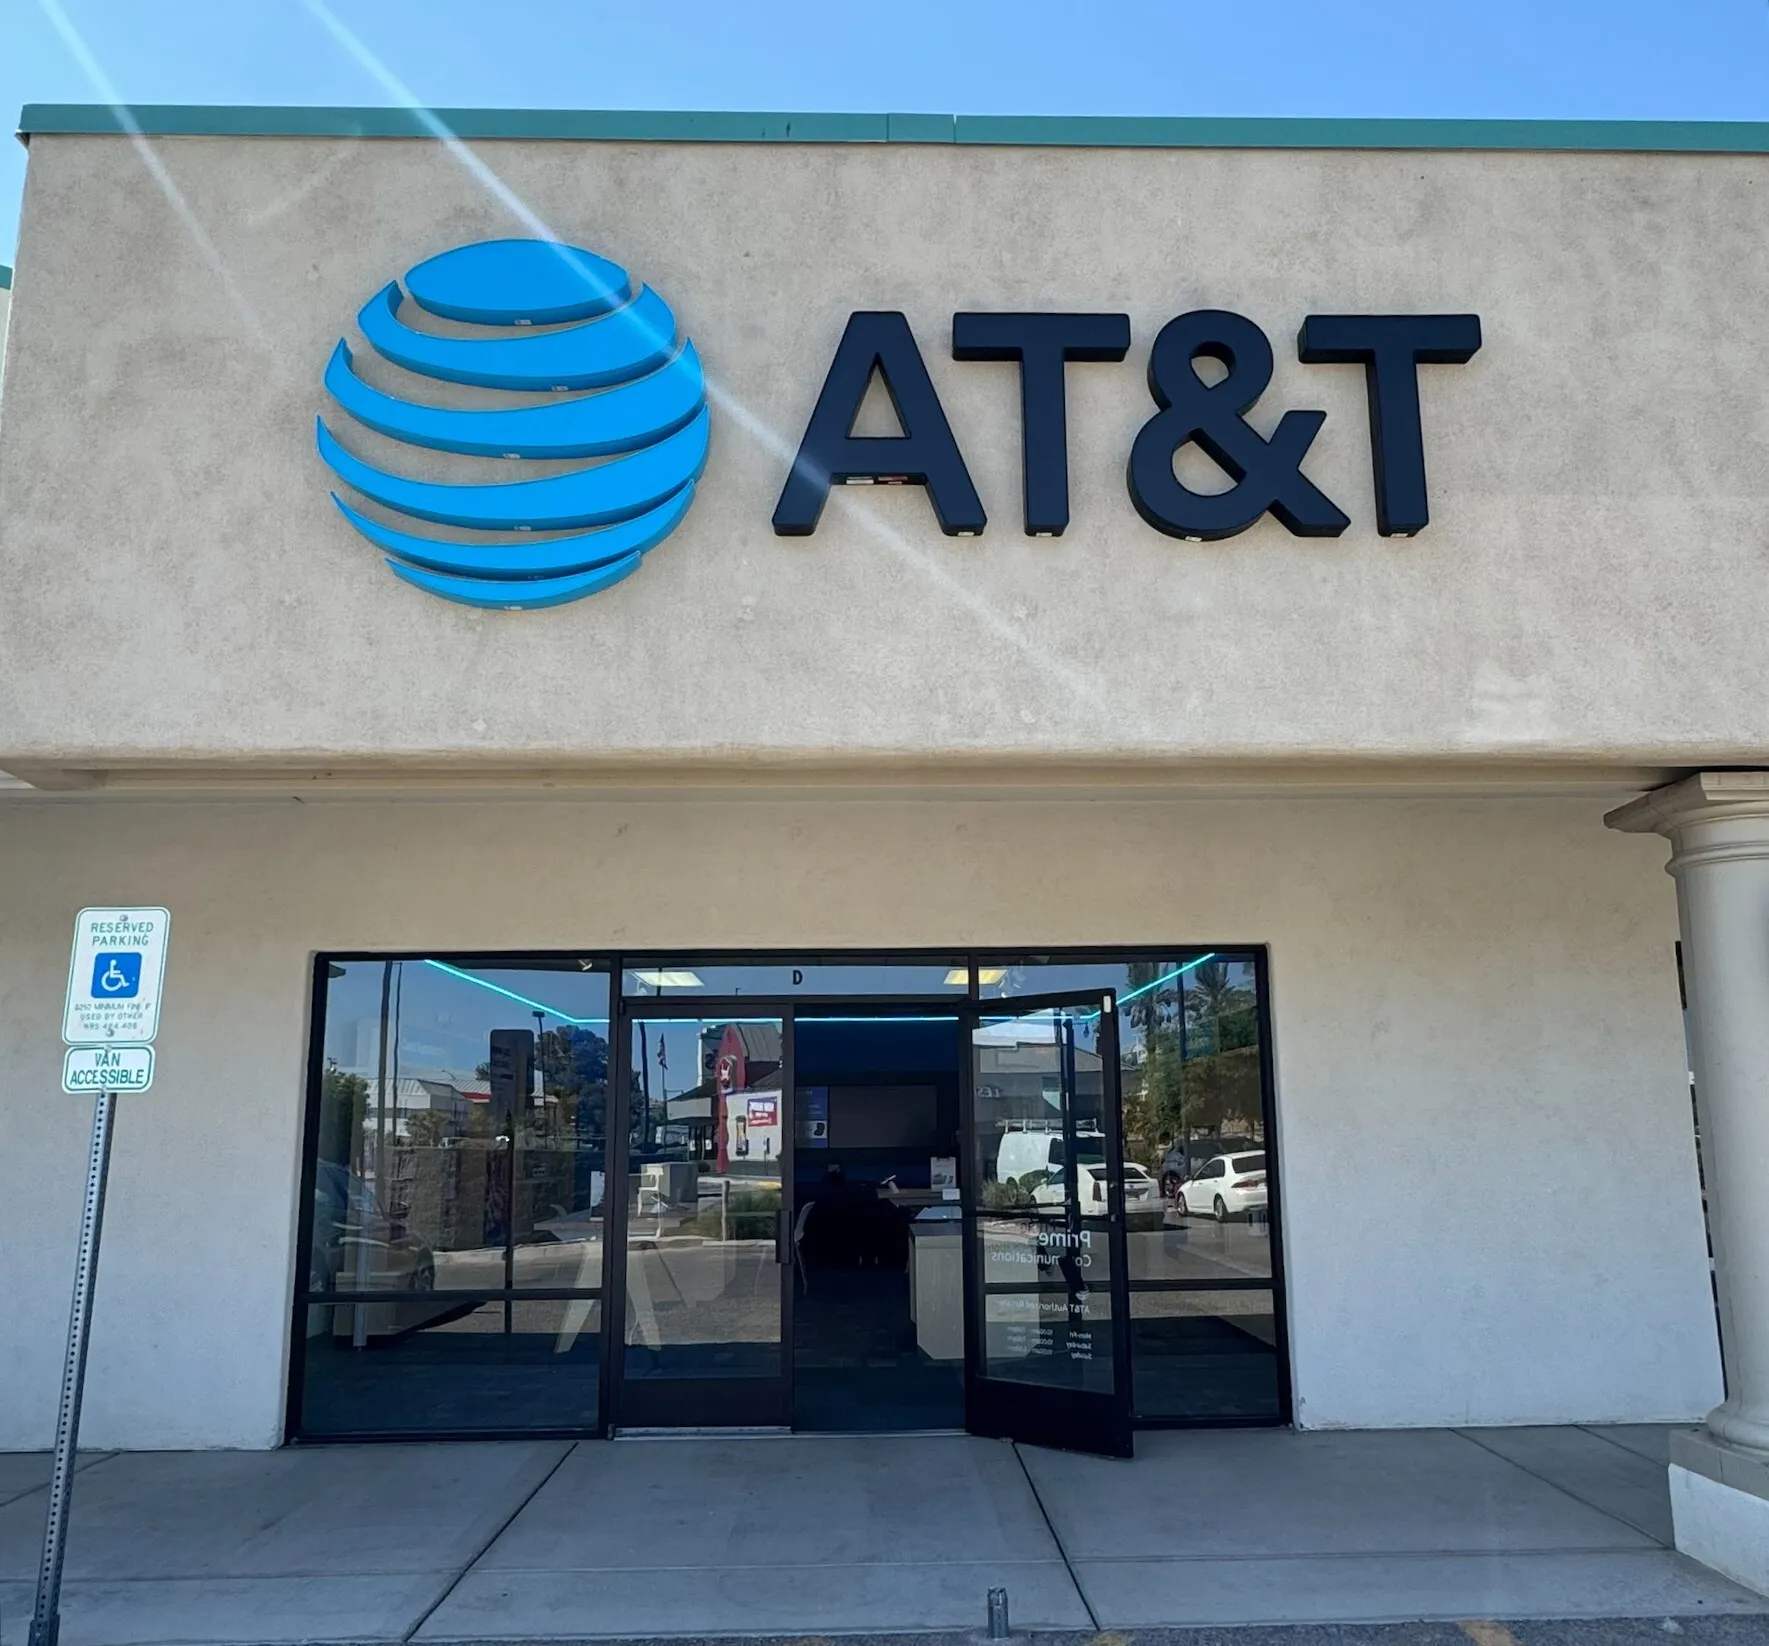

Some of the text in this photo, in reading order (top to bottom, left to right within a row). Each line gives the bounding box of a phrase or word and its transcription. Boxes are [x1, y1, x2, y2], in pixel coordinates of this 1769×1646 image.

[771, 309, 1482, 541] AT&T
[91, 922, 154, 933] RESERVED
[92, 935, 149, 946] PARKING
[793, 970, 803, 985] D
[95, 1053, 121, 1067] VAN
[70, 1069, 144, 1085] ACCESSIBLE
